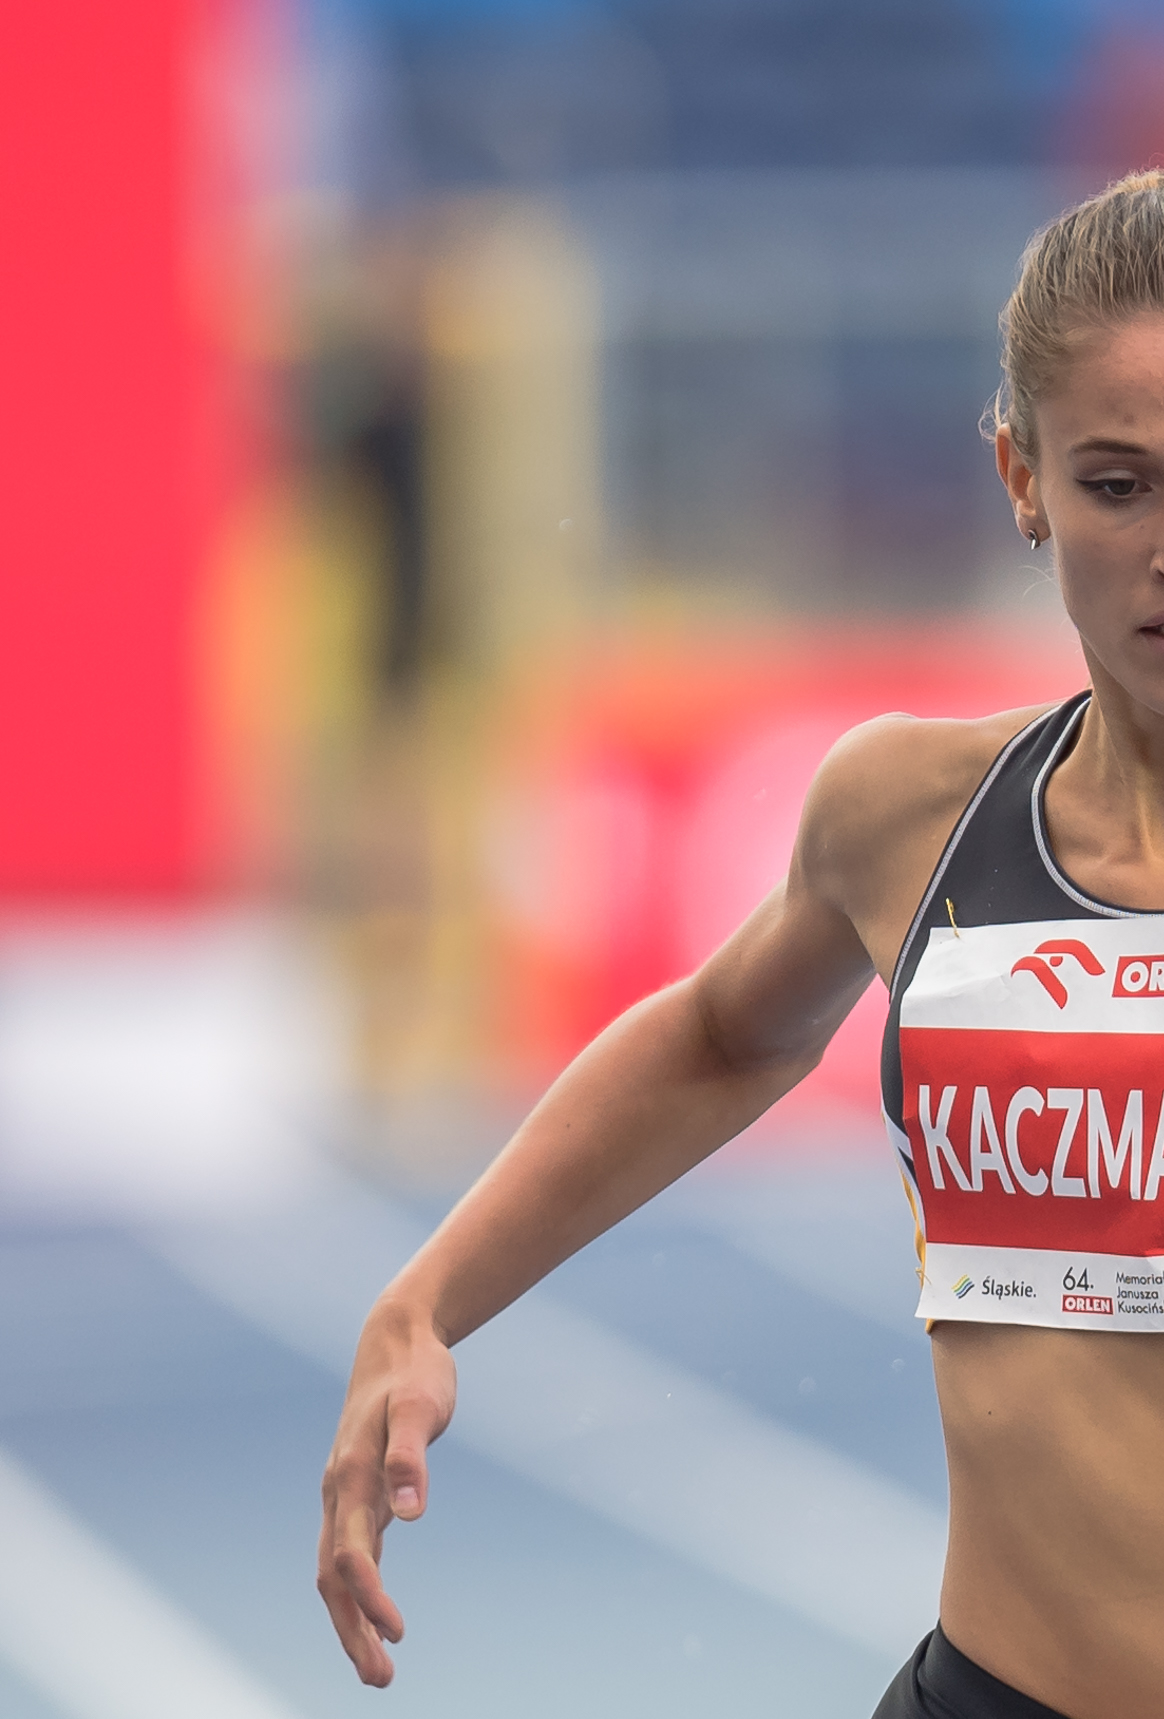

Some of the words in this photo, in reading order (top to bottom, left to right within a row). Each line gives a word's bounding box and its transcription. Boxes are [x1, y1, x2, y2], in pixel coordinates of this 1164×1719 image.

[981, 1275, 1037, 1300] Śląskie.
[1062, 1266, 1094, 1291] 64.
[1116, 1286, 1159, 1300] Janusza
[1064, 1297, 1111, 1313] ORLEN
